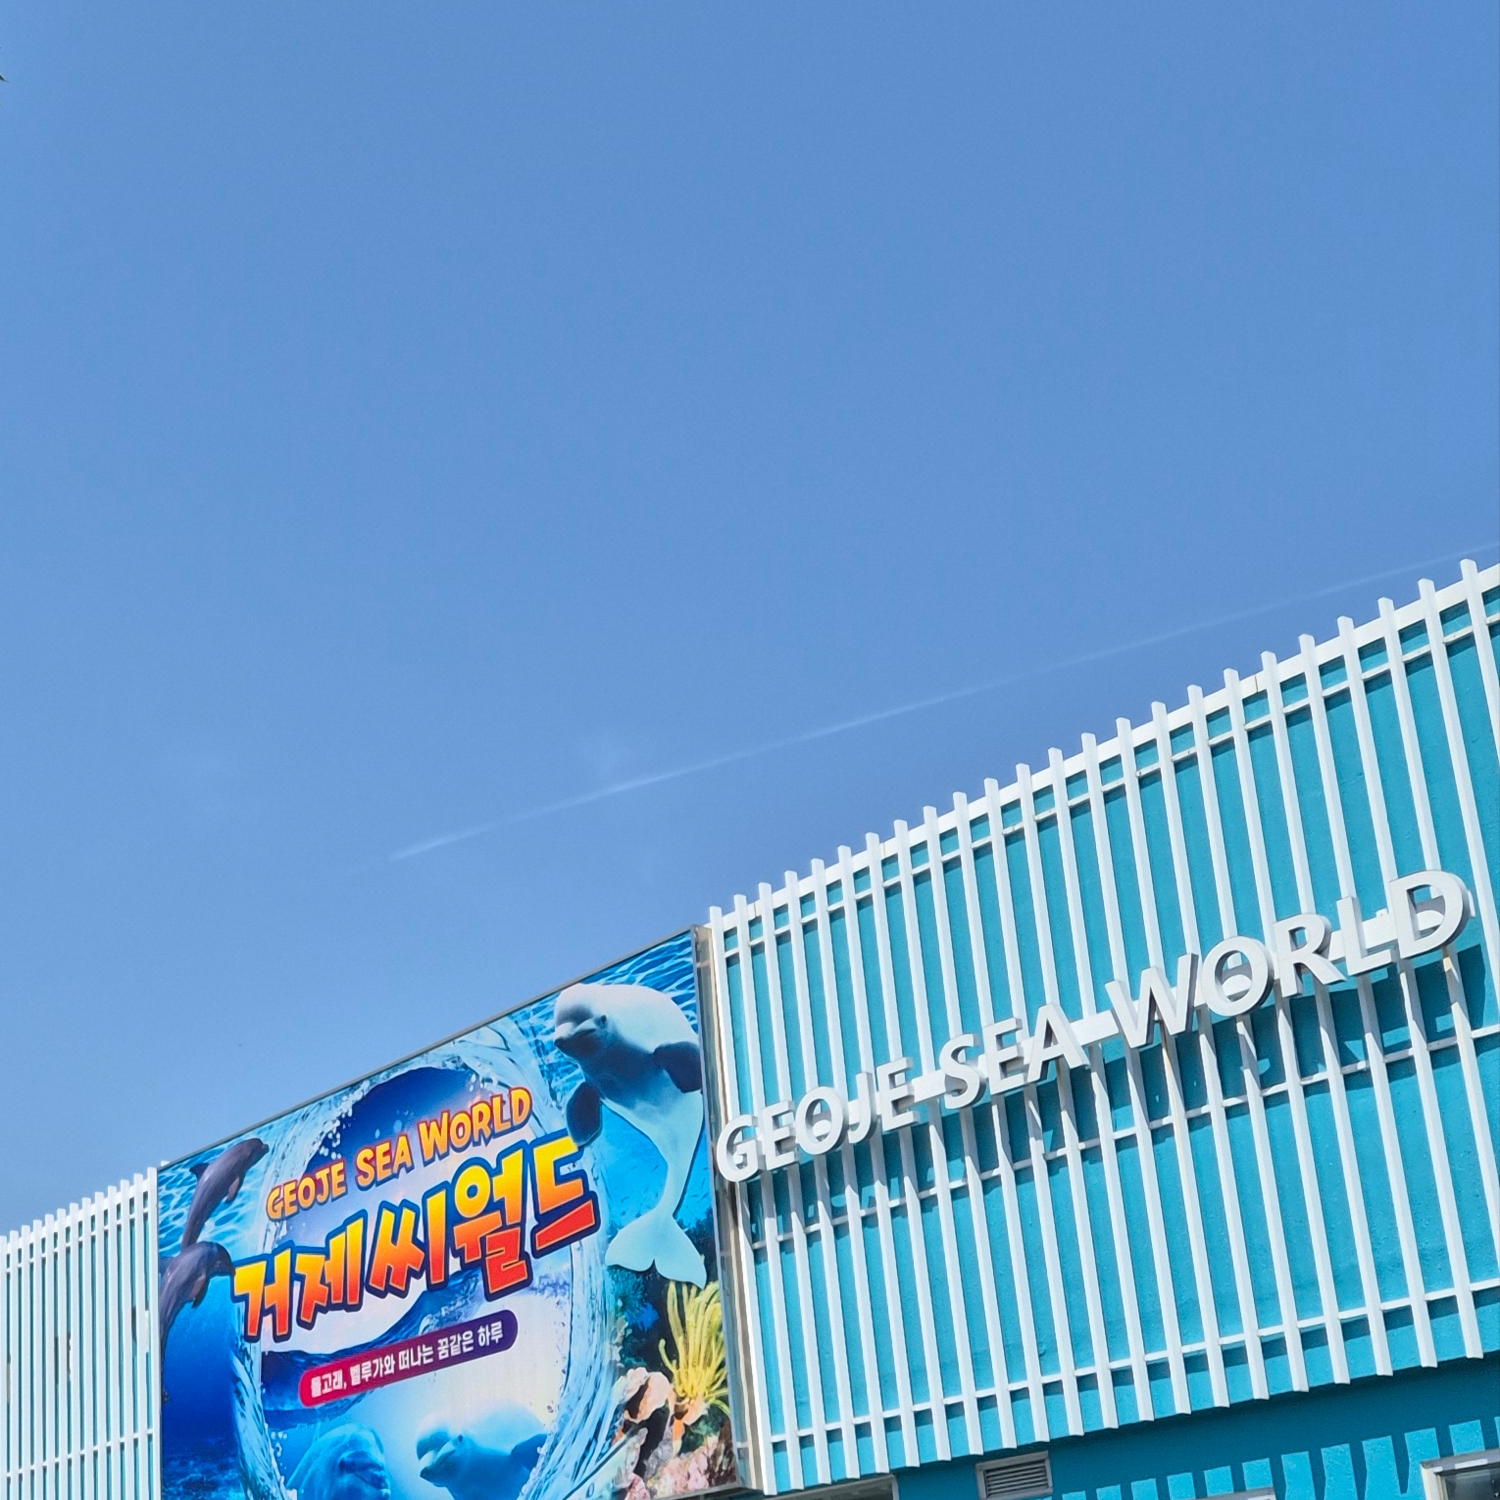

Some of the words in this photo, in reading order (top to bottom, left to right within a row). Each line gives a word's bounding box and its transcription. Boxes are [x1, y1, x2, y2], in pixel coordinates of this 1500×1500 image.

[717, 1056, 919, 1183] GEOJE
[939, 1002, 1091, 1109] SEA
[1104, 869, 1476, 1049] WORLD
[232, 1131, 600, 1339] 거제씨월드
[265, 1160, 348, 1221] GEOJE
[354, 1132, 414, 1192] SEA
[418, 1085, 534, 1168] WORLD
[310, 1367, 348, 1399] 돌고래,
[349, 1354, 396, 1387] 벨루가와
[398, 1344, 434, 1371] 떠나는
[436, 1330, 474, 1360] 꿈같은
[477, 1320, 504, 1347] 하루
